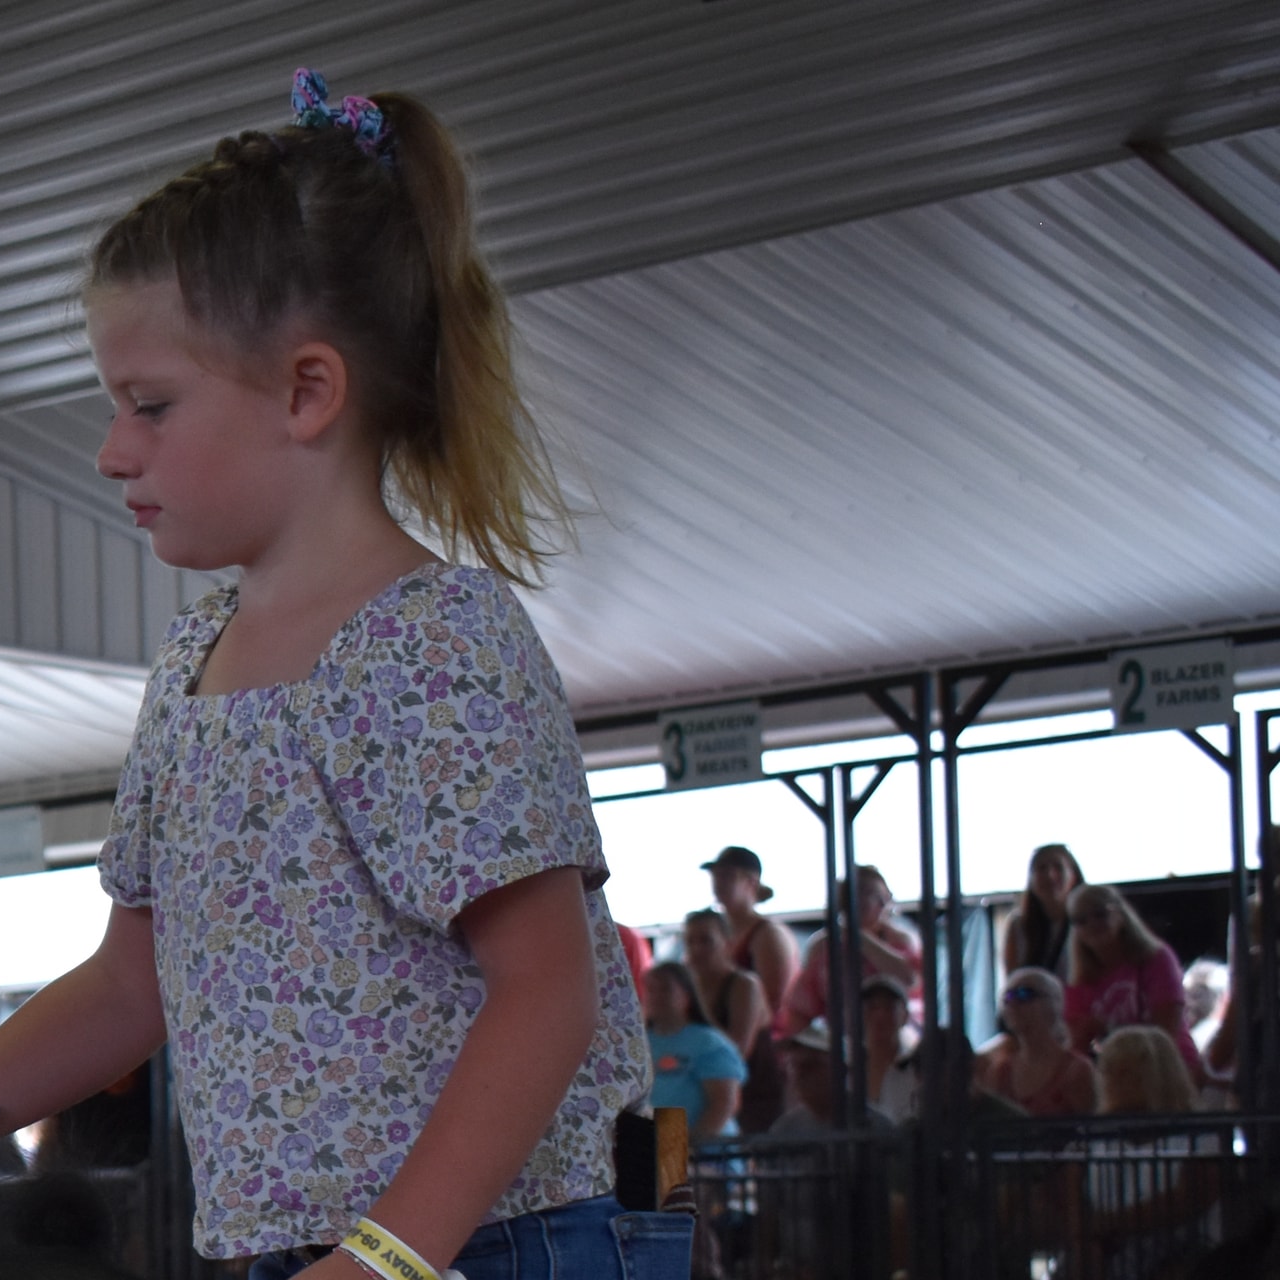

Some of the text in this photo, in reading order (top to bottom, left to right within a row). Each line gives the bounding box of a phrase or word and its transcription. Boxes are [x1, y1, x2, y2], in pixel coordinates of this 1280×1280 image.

[1151, 661, 1225, 685] BLAZER
[1118, 658, 1146, 725] 2
[1156, 685, 1221, 707] FARMS
[664, 720, 686, 782] 3
[696, 756, 749, 775] MEATS
